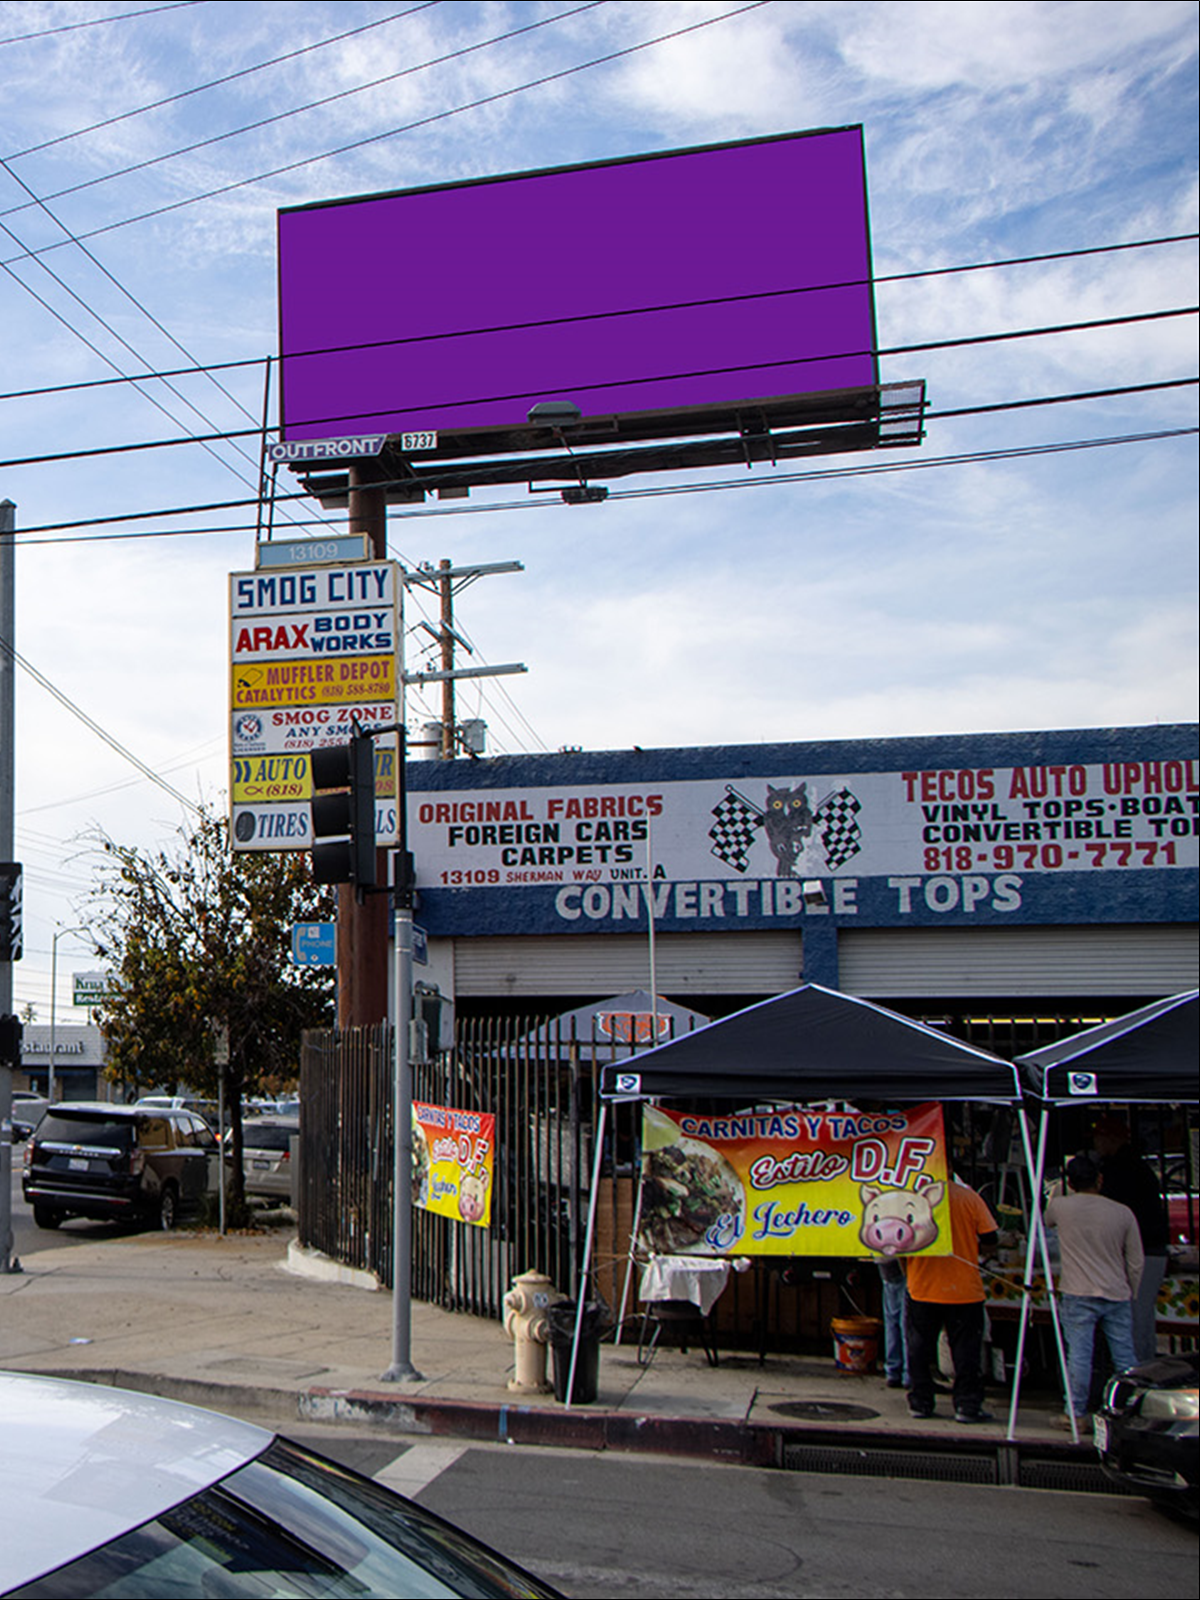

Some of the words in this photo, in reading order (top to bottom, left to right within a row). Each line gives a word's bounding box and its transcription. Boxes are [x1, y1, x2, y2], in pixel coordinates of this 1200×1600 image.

[272, 438, 380, 459] OUTFRONT
[404, 433, 434, 449] 6737
[289, 543, 338, 560] 13109
[238, 574, 316, 609] SMOG
[328, 568, 388, 602] CITY
[314, 613, 388, 632] BODY
[235, 624, 309, 653] ARAX
[310, 632, 392, 652] WORKS
[267, 663, 334, 686] MUFFLER
[340, 660, 390, 682] DEPOT
[236, 686, 316, 704] CATALYTICS
[272, 709, 331, 727] SMOG
[337, 705, 393, 722] ZONE
[286, 726, 321, 738] ANY
[255, 757, 307, 782] AUTO
[266, 783, 303, 797] (818)
[902, 768, 994, 802] TECOS
[1008, 764, 1087, 799] AUTO
[418, 799, 534, 824] ORIGINAL
[547, 794, 663, 819] FABRICS
[921, 803, 1008, 823] VINYL
[1022, 798, 1106, 819] TOPS
[258, 811, 308, 839] TIRES
[448, 822, 560, 848] FOREIGN
[575, 819, 649, 842] CARS
[921, 819, 1133, 843] CONVERTIBLE
[501, 844, 633, 867] CARPETS
[923, 840, 1177, 872] 818-970-7771
[440, 868, 500, 885] 13109
[505, 870, 563, 884] SHERMAN
[572, 868, 602, 882] WAY
[652, 864, 667, 880] A
[555, 879, 858, 920] CONVERTIBLE
[888, 874, 1024, 914] TOPS
[301, 939, 333, 949] PHONE
[417, 1104, 446, 1129] CARNITAS
[453, 1112, 481, 1133] TACOS
[681, 1114, 800, 1139] CARNITAS
[804, 1115, 822, 1140] Y
[826, 1114, 908, 1139] TACOS
[749, 1150, 850, 1190] Estilo
[705, 1213, 745, 1249] El
